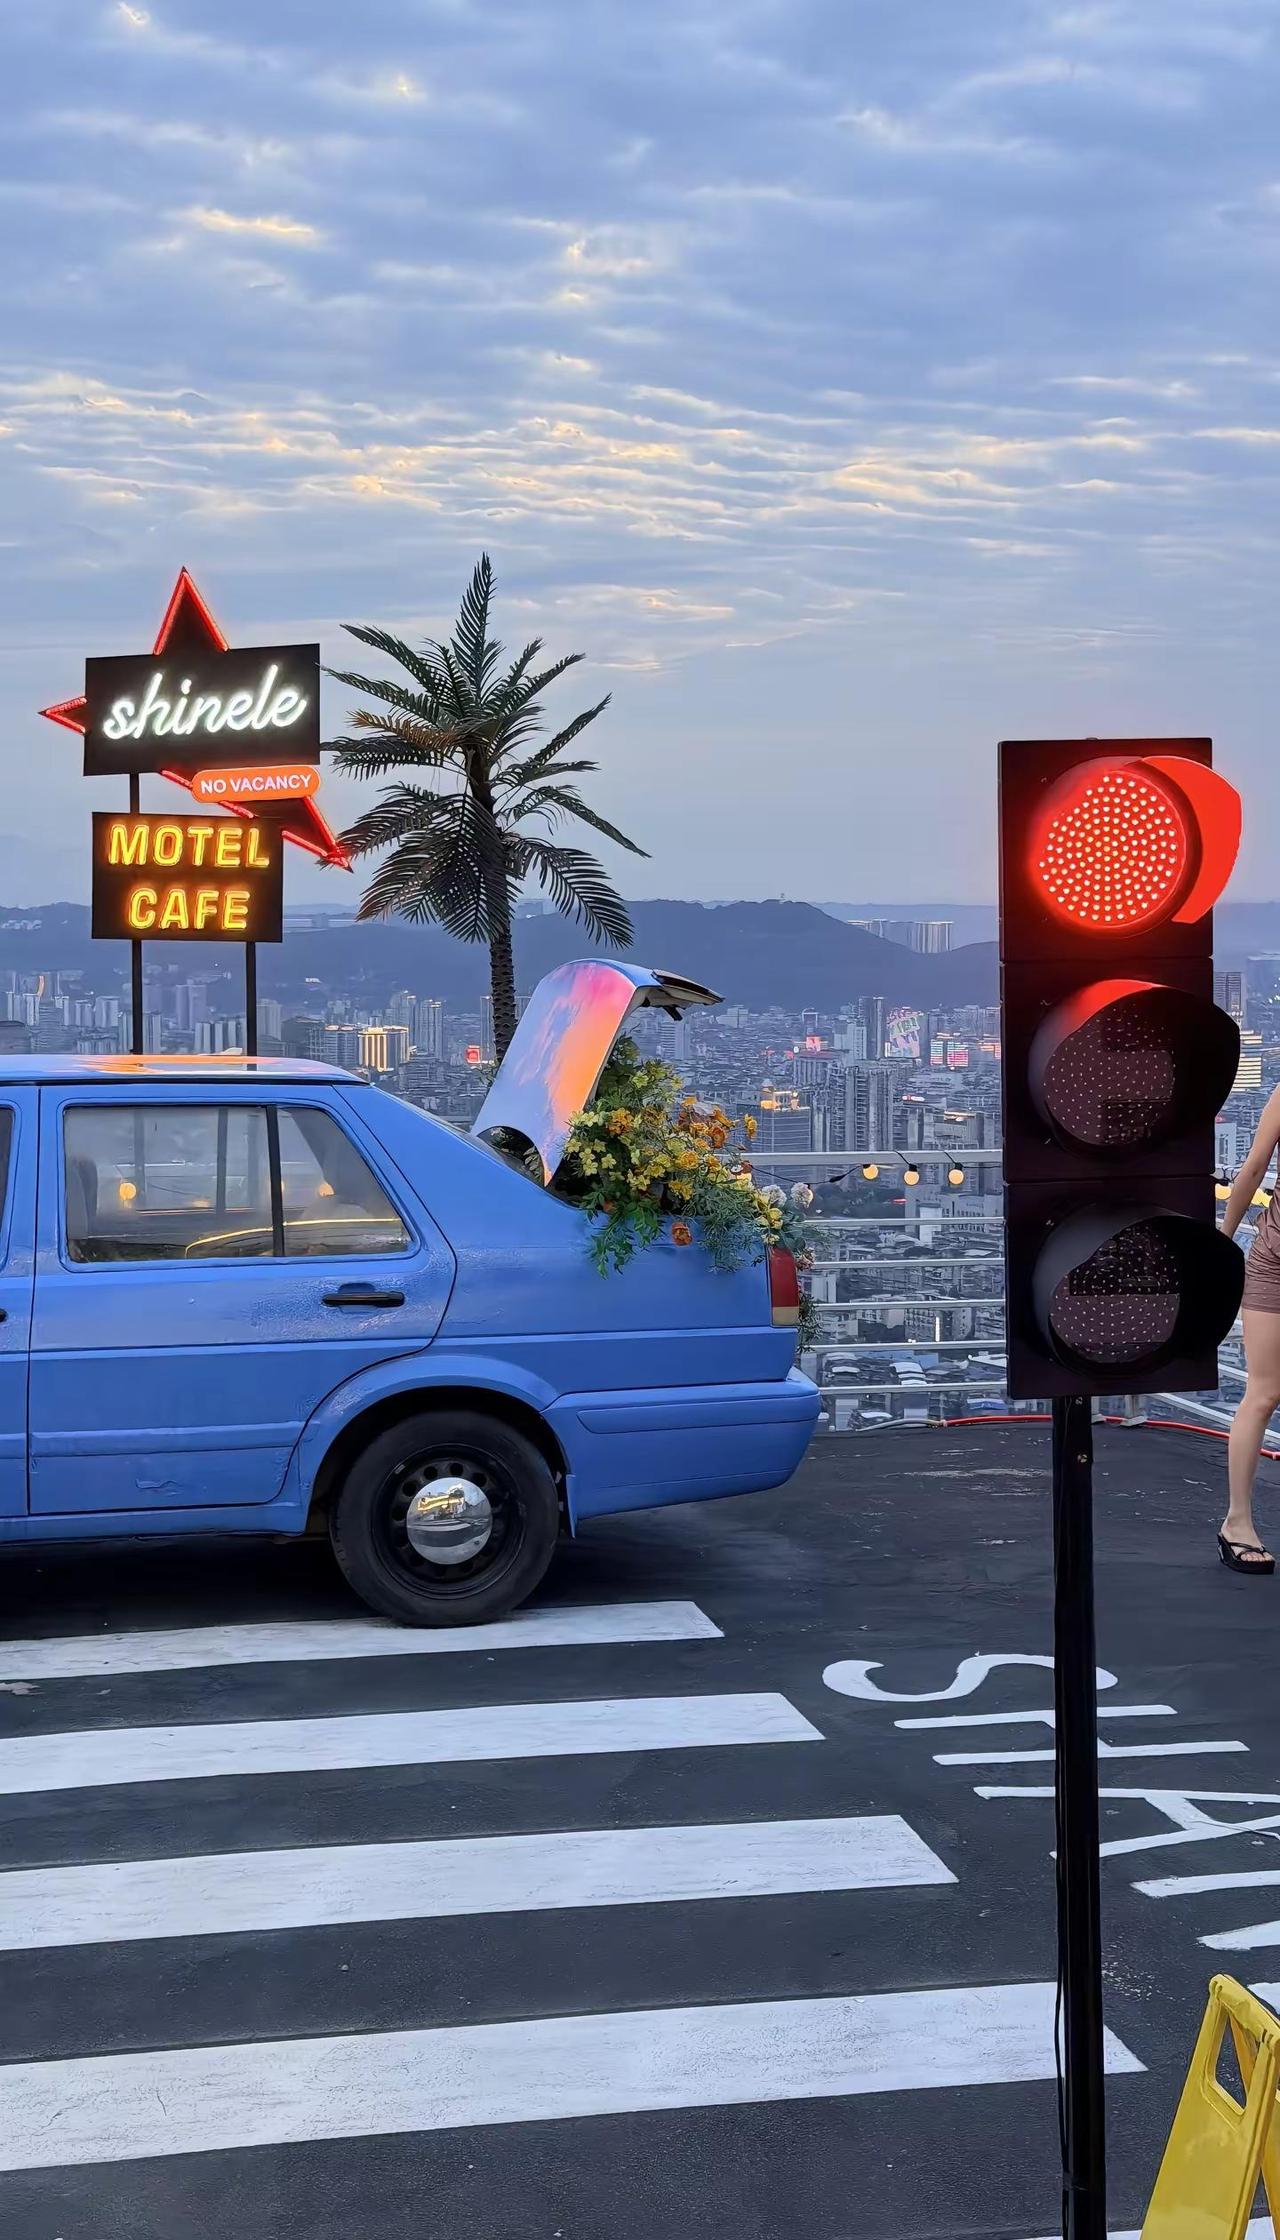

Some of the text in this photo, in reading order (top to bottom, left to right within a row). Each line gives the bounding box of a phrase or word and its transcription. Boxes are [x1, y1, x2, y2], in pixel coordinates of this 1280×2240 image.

[103, 664, 307, 740] shinele
[200, 773, 312, 795] NO VACANCY
[108, 823, 270, 869] MOTEL
[128, 886, 251, 931] CAFE
